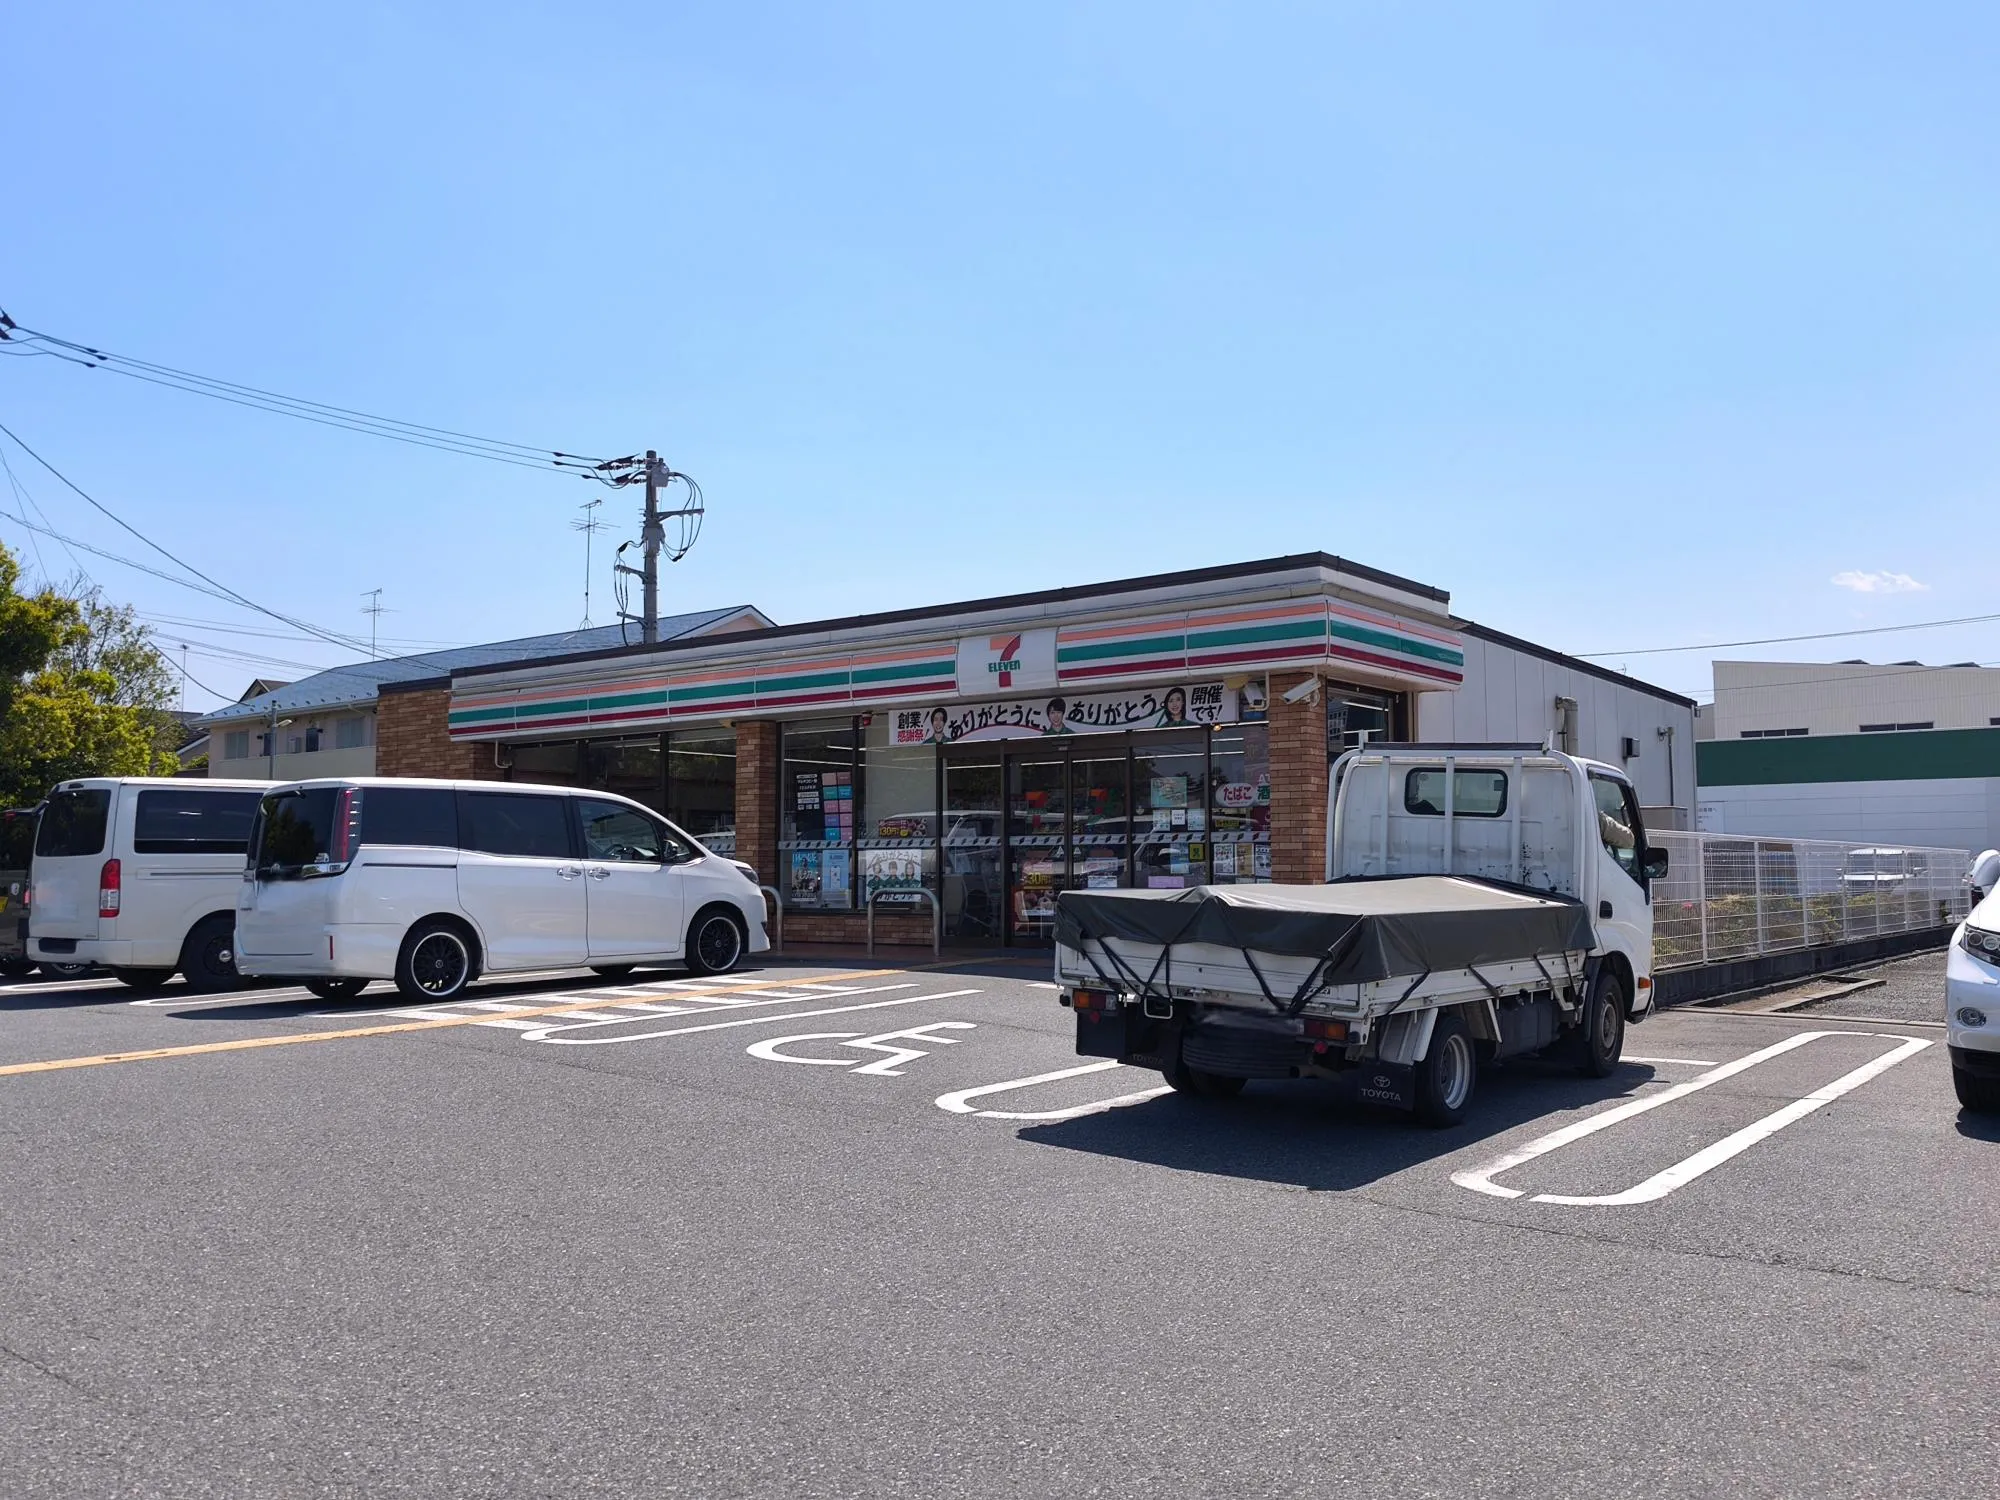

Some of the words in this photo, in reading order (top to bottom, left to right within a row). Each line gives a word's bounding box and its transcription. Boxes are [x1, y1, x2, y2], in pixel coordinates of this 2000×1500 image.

[990, 634, 1021, 687] 7
[1191, 685, 1224, 706] 開催
[1067, 693, 1157, 725] ありがとう
[1223, 785, 1253, 801] たばこ
[1257, 785, 1271, 800] 酒
[1360, 1087, 1402, 1103] TOYOTA
